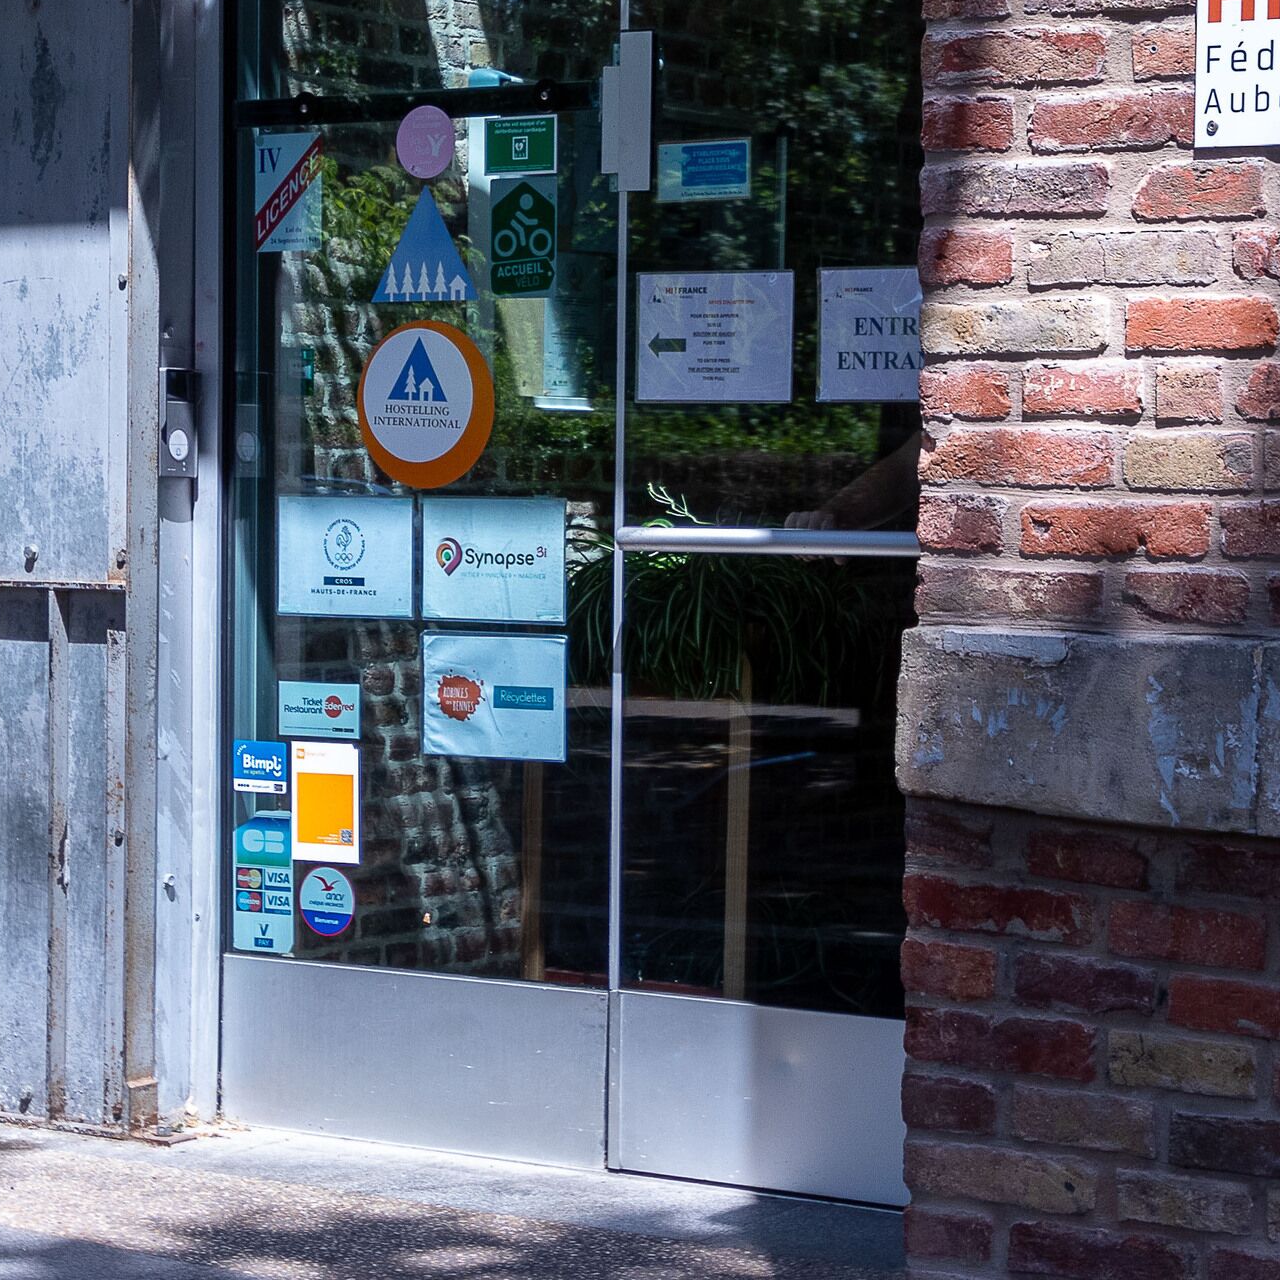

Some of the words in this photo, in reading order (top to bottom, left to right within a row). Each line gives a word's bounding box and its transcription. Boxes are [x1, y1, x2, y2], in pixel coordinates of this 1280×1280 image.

[259, 147, 281, 174] IV
[258, 147, 319, 241] LICENCE
[497, 262, 544, 278] ACCUEIL
[678, 286, 707, 295] FRANCE
[855, 317, 920, 336] ENTR
[385, 404, 449, 416] HOSTELLING
[374, 416, 461, 429] INTERNATIONAL
[465, 548, 534, 569] Synapse
[536, 545, 547, 558] 3i
[302, 697, 323, 706] Ticket
[324, 701, 354, 711] Edenred
[284, 705, 323, 714] Restaurant
[243, 753, 282, 773] Bimpli
[267, 872, 290, 884] VISA
[267, 895, 290, 907] VISA
